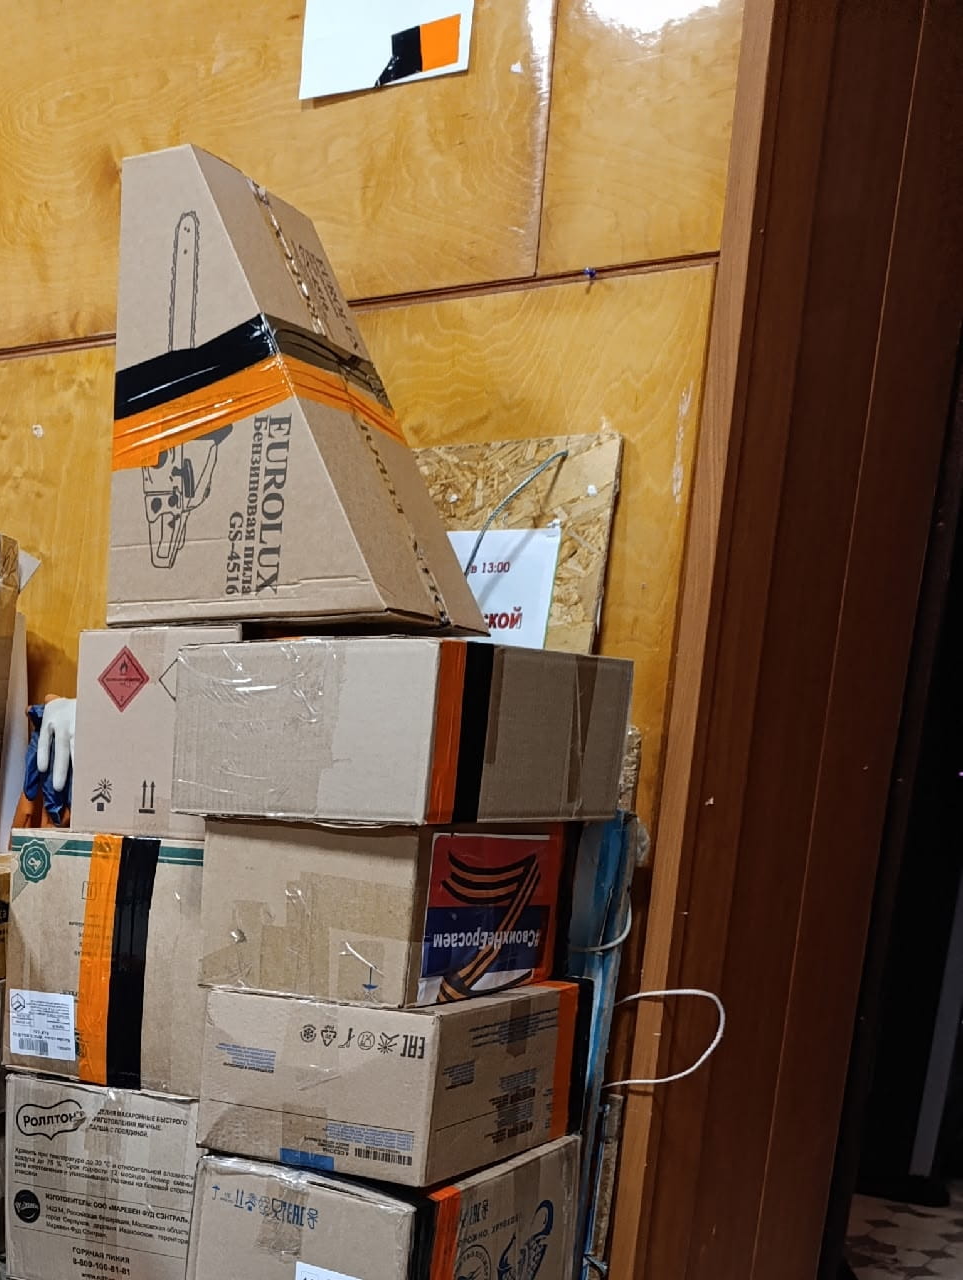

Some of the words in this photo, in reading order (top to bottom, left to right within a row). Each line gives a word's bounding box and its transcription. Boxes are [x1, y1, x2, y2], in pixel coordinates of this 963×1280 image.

[244, 415, 268, 541] Бензиновая
[255, 412, 292, 596] EUROLUX
[225, 511, 243, 595] GS-4516
[241, 546, 254, 595] пила
[482, 562, 511, 573] 13:00
[72, 1246, 105, 1259] ГОРЯЧАЯ
[106, 1253, 130, 1264] ЛИНИЯ
